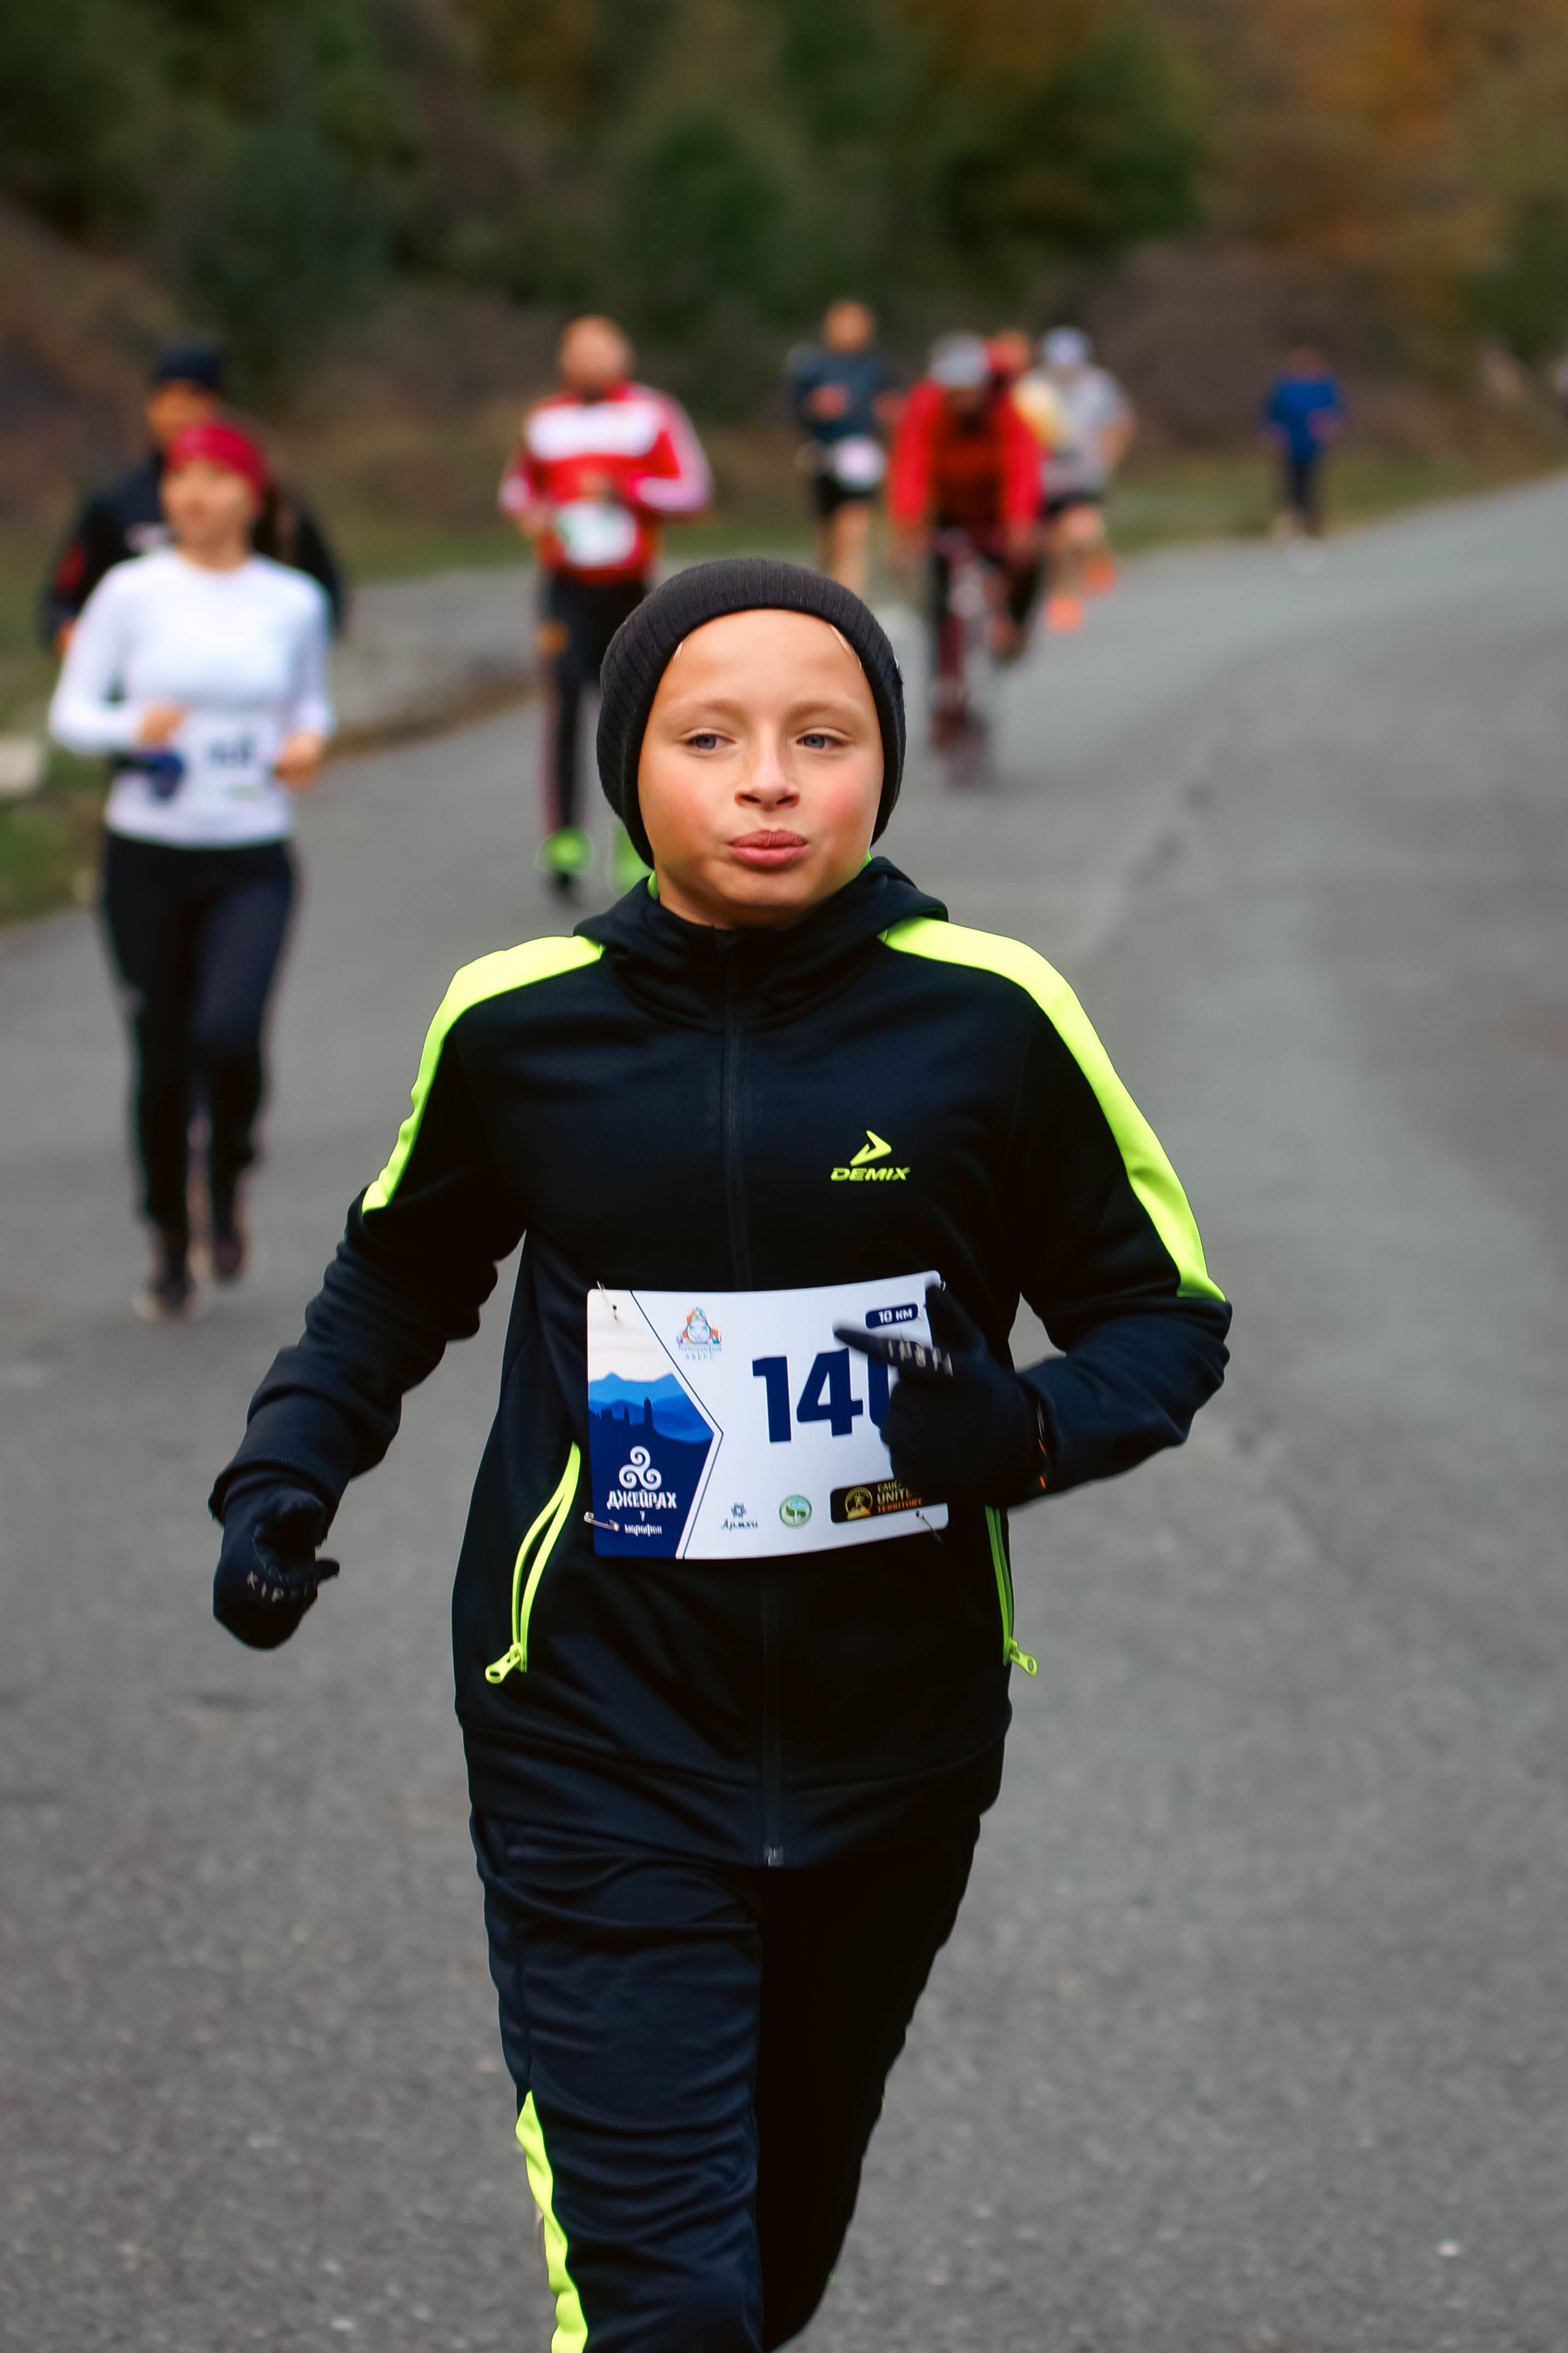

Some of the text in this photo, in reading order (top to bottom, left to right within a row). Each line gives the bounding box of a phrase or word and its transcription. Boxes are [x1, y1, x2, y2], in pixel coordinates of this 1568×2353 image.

[831, 1167, 910, 1181] DEMIX
[878, 1310, 892, 1324] 10
[606, 1489, 677, 1510] ДЖЕЙРАХ
[877, 1497, 922, 1514] TERRITORY
